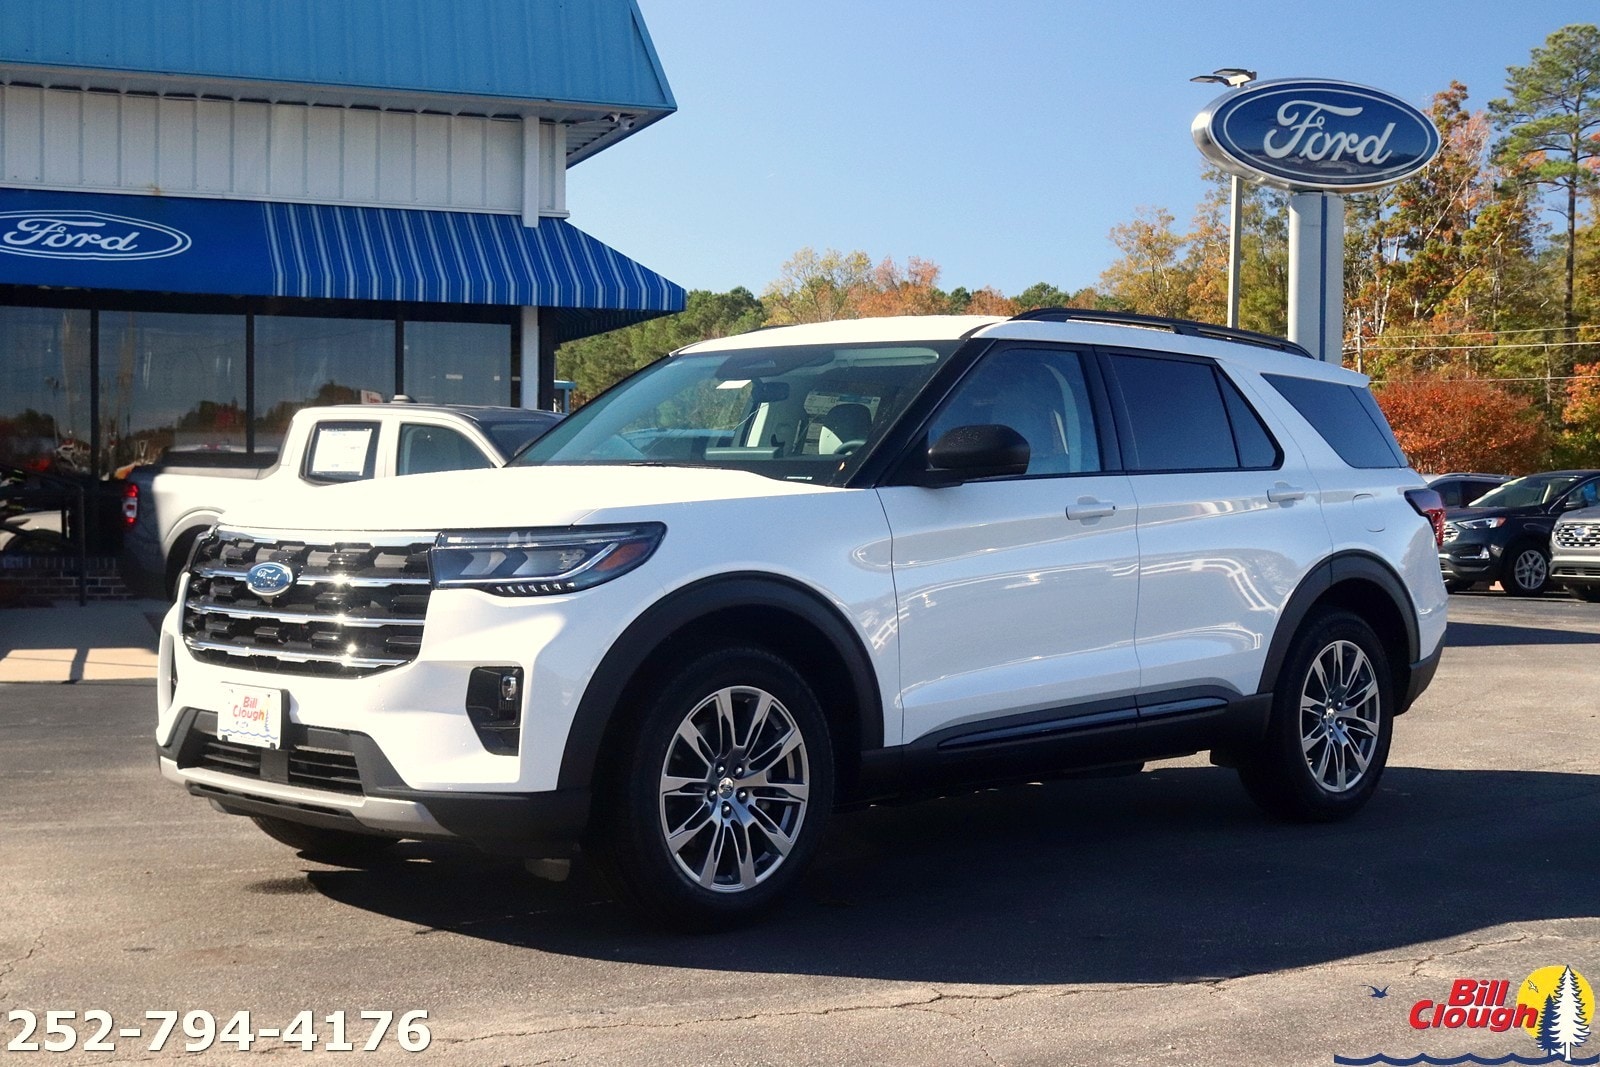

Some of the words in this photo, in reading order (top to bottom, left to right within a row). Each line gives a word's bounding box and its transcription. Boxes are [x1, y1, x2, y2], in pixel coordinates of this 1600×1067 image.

[1264, 100, 1396, 165] Ford
[3, 218, 140, 251] Ford
[254, 568, 280, 587] Ford
[243, 696, 258, 709] Bill
[233, 705, 265, 721] Clough
